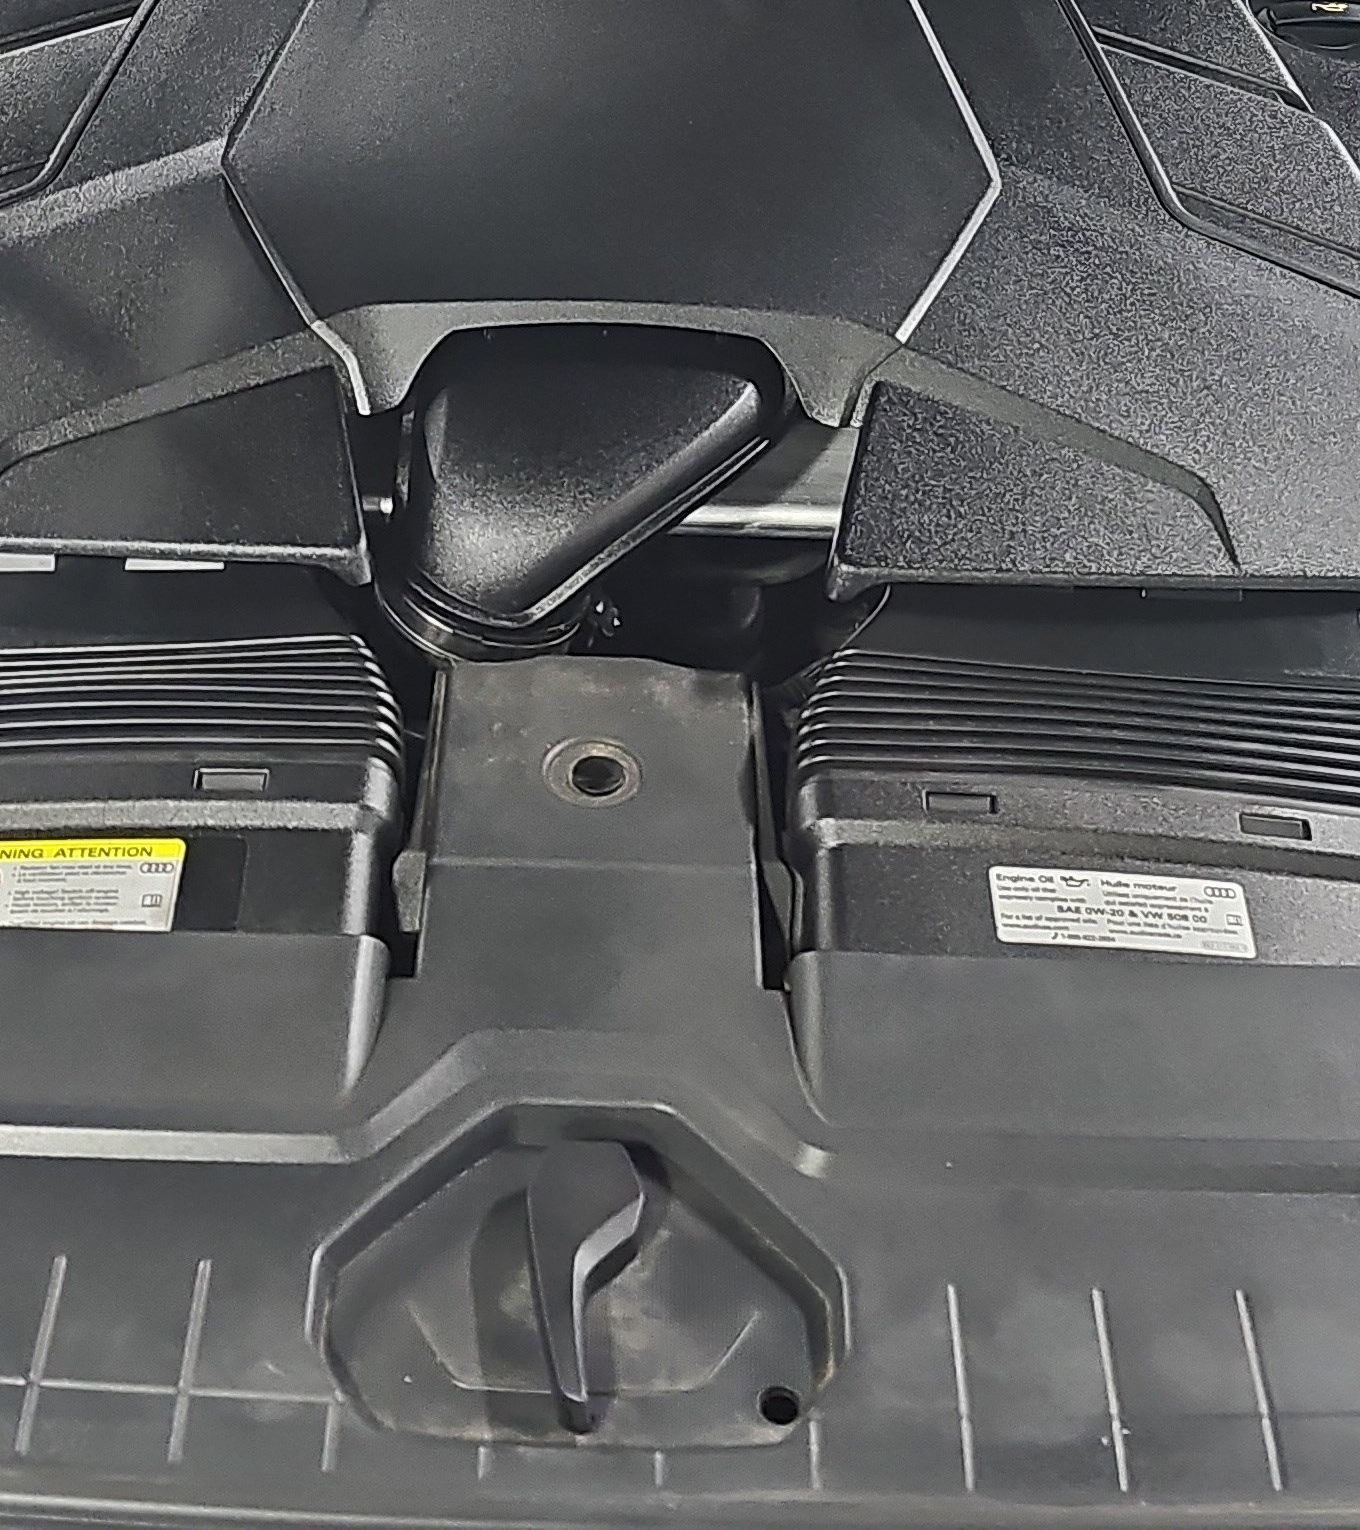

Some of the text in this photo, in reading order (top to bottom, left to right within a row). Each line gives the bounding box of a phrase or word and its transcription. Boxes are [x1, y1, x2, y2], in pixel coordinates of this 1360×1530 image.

[53, 846, 153, 859] ATTENTION
[995, 872, 1055, 884] Engine Oil
[1132, 882, 1178, 892] moteur
[1056, 904, 1082, 915] SAE
[1084, 906, 1125, 918] 0W-20
[1140, 910, 1164, 921] VW
